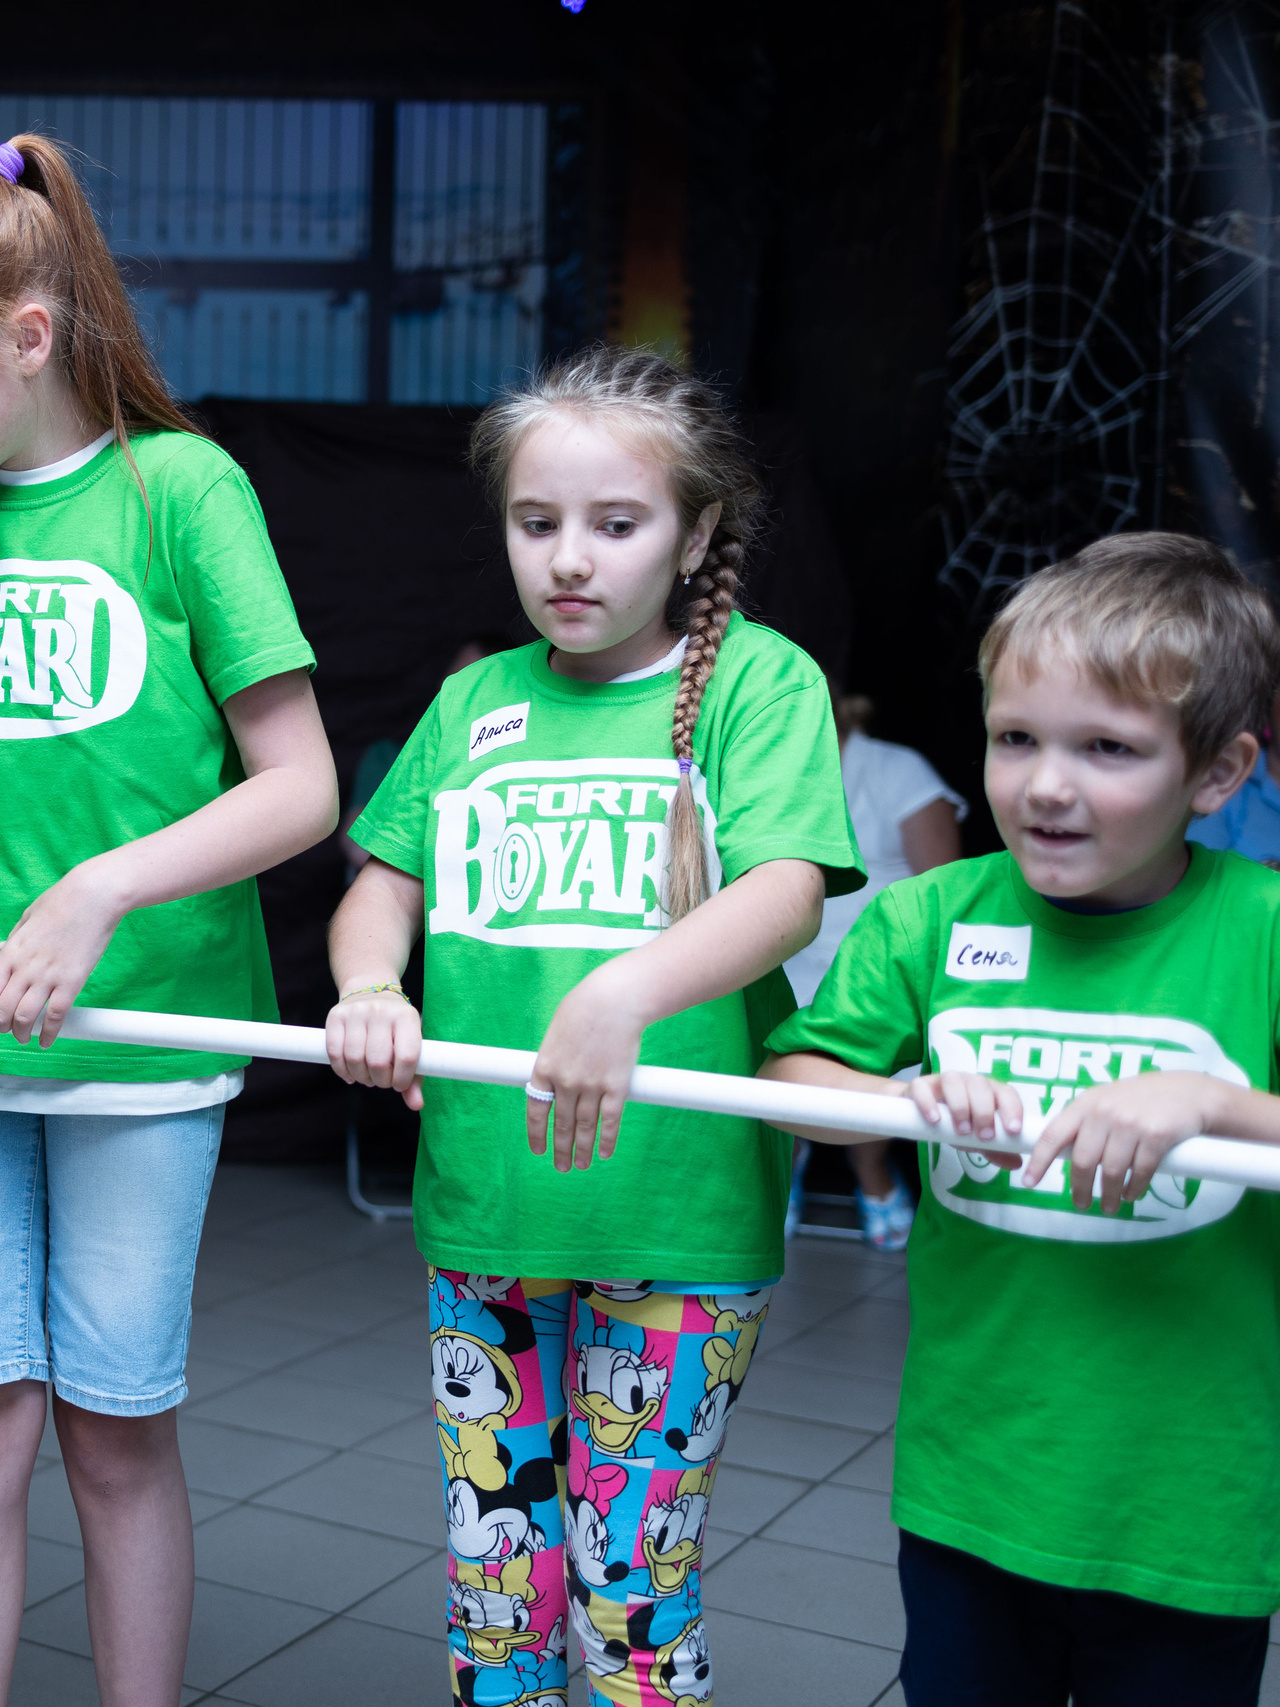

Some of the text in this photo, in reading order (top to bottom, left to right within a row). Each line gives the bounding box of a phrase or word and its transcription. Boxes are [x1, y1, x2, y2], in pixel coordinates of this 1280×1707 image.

[471, 718, 524, 750] Алиса
[506, 781, 660, 817] FORT
[956, 943, 1018, 966] Сеня
[977, 1034, 1154, 1084] FORT
